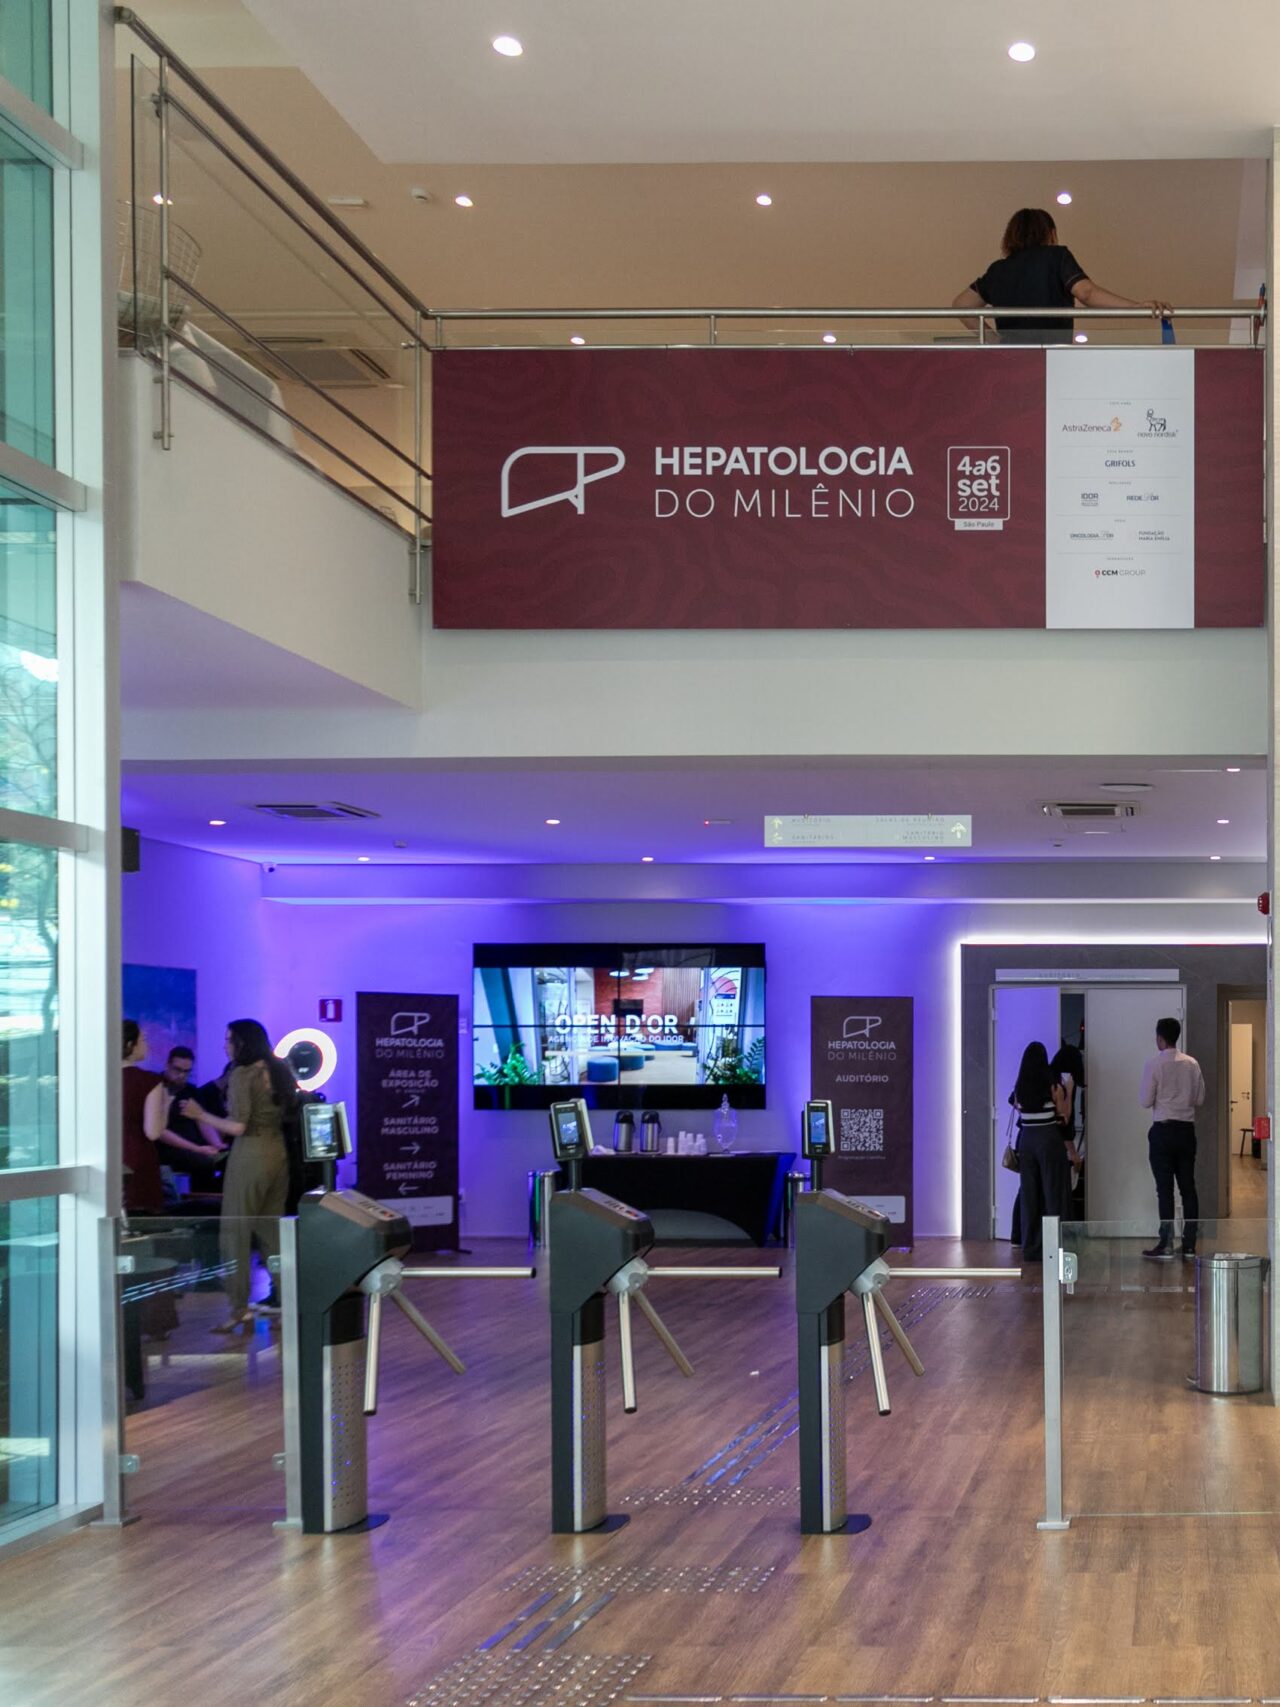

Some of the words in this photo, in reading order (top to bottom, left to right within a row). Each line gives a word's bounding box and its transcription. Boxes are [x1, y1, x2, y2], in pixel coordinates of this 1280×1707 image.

[1062, 424, 1112, 433] AstraZeneca
[655, 446, 914, 476] HEPATOLOGIA
[1104, 459, 1136, 468] GRIFOLS
[957, 475, 1000, 497] set
[655, 488, 715, 518] DO
[733, 483, 915, 518] MILÊNIO
[958, 497, 1000, 512] 2024
[554, 1014, 616, 1034] OPEN
[625, 1014, 679, 1034] D'OR
[375, 1037, 444, 1048] HEPATOLOGIA
[828, 1040, 896, 1050] HEPATOLOGIA
[375, 1048, 394, 1058] DO
[828, 1051, 845, 1061] DO
[848, 1050, 897, 1061] MILÊNIO
[381, 1077, 440, 1088] EXPOSIÇÃO
[835, 1073, 889, 1083] AUDITÓRIO
[383, 1115, 438, 1126] SANITÁRIO
[381, 1126, 440, 1135] MASCULINO
[383, 1160, 438, 1171] SANITÁRIO
[385, 1170, 435, 1180] FEMININO
